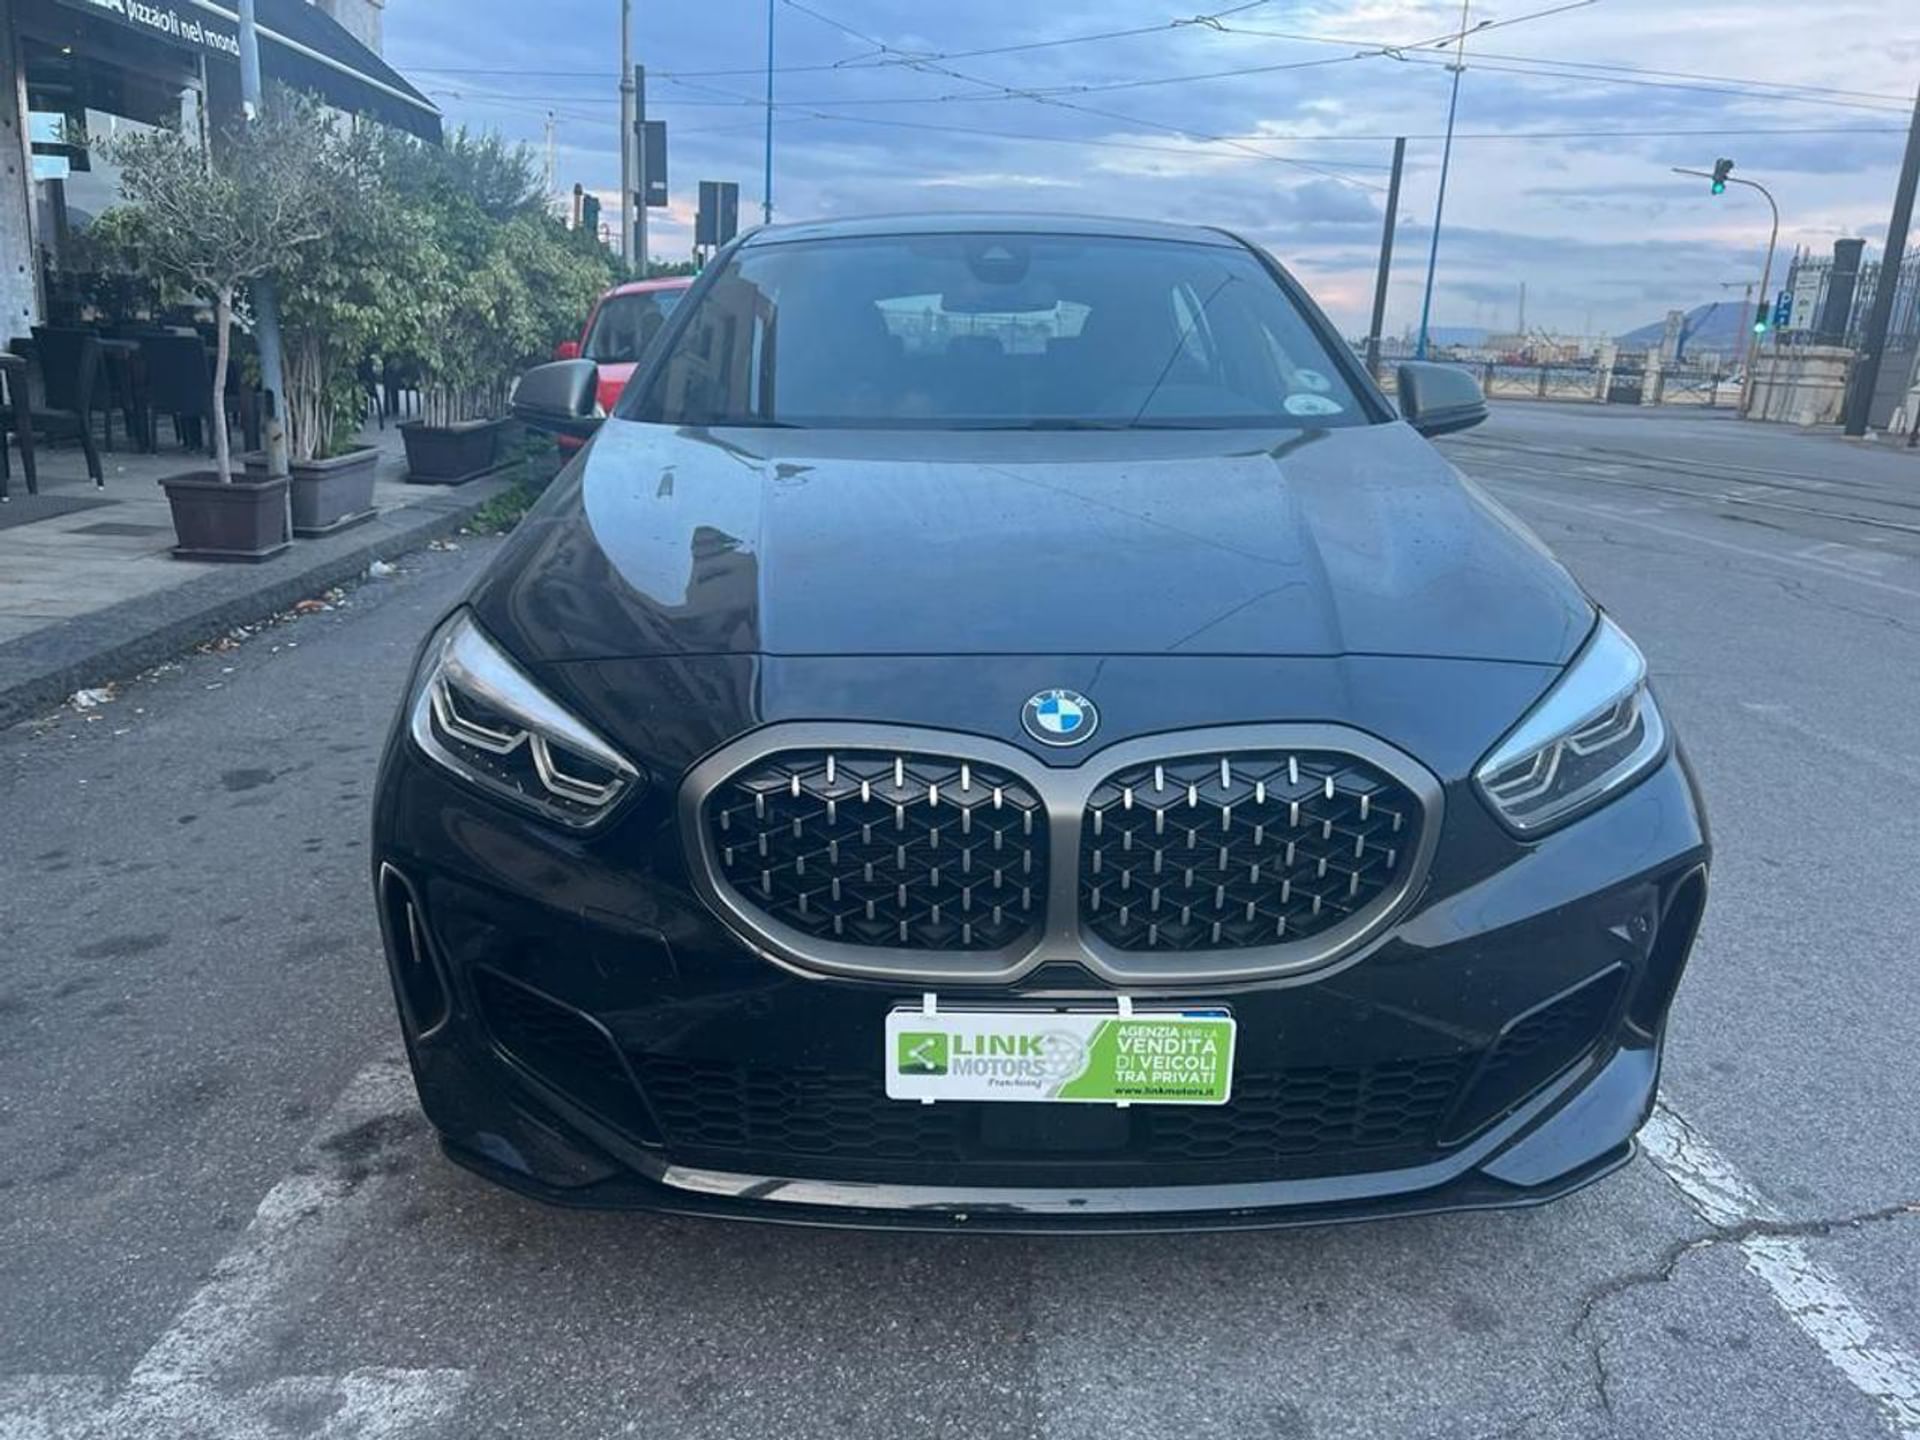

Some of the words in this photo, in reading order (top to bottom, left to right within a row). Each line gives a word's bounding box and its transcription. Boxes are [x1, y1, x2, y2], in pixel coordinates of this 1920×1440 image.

[180, 20, 204, 44] nel
[204, 29, 241, 57] mond
[1118, 1026, 1180, 1038] AGENZIA
[953, 1035, 1044, 1056] LINK
[1117, 1038, 1217, 1055] VENDITA
[952, 1058, 1047, 1077] MOTORS
[1116, 1055, 1135, 1070] DI
[1140, 1056, 1217, 1071] VEICOLI
[1116, 1070, 1147, 1083] TRA
[1151, 1071, 1216, 1084] PRIVATI
